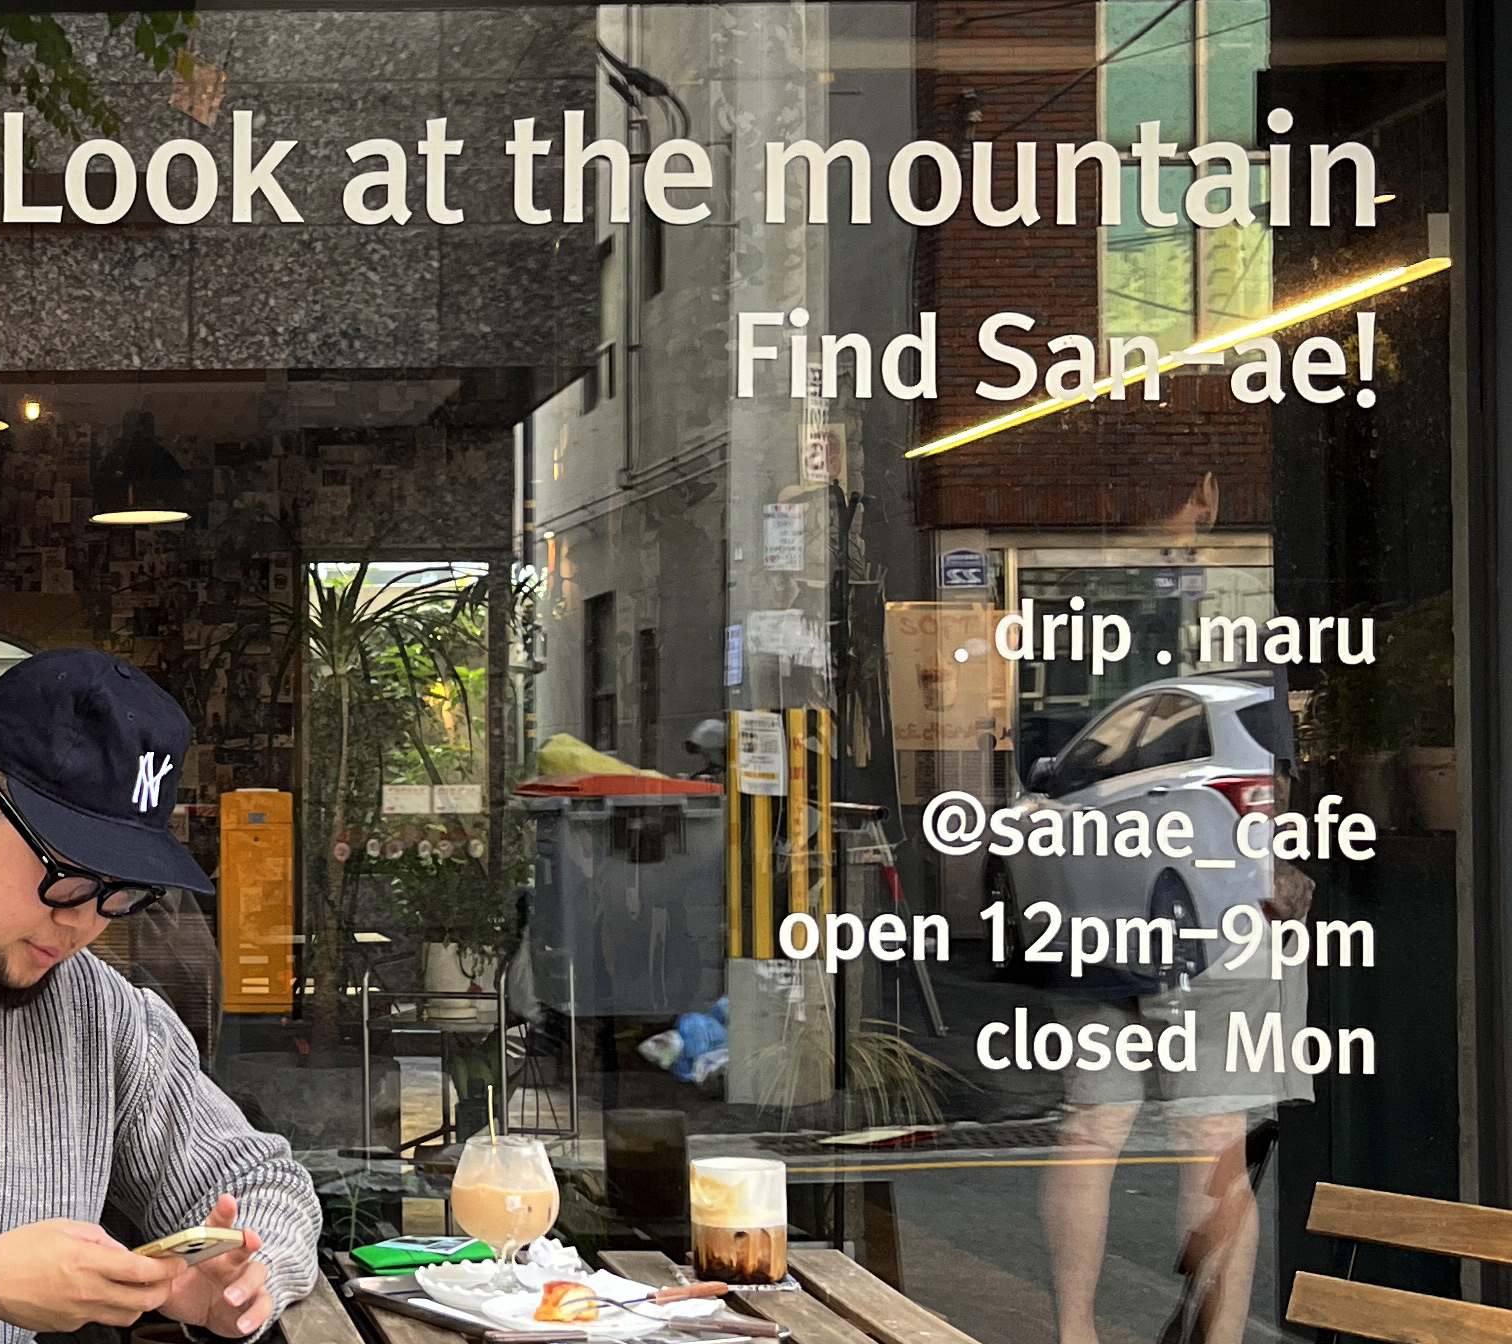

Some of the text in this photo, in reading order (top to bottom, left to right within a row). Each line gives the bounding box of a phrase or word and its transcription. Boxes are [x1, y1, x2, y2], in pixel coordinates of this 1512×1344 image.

[3, 108, 1377, 227] Look at the mountain
[737, 308, 1376, 409] Find San-ae!
[995, 595, 1131, 675] drip
[1199, 613, 1376, 665] maru
[131, 751, 174, 813] NY
[922, 790, 1376, 872] @sanae_cafe
[779, 909, 949, 974] open
[976, 1007, 1376, 1075] closed Mon
